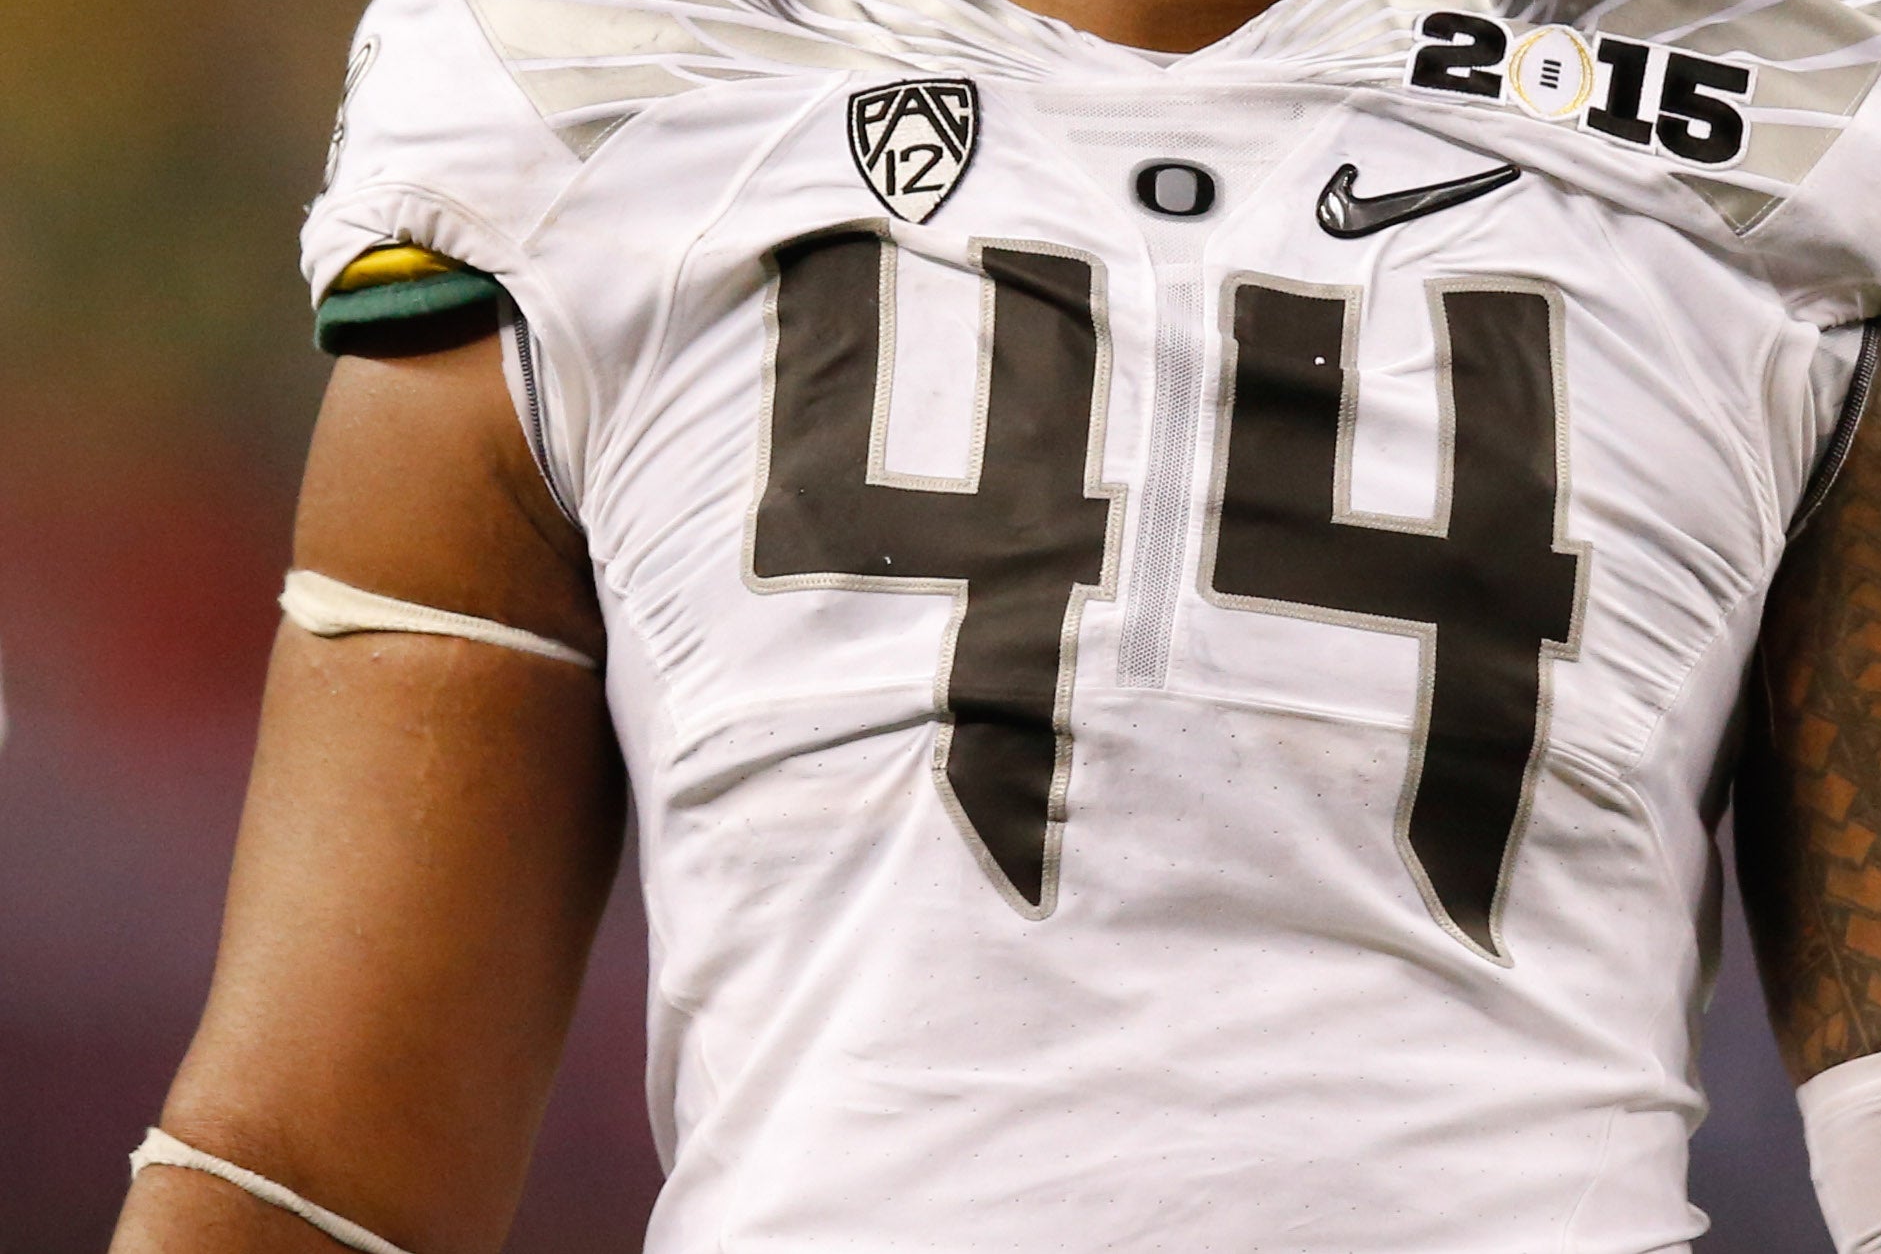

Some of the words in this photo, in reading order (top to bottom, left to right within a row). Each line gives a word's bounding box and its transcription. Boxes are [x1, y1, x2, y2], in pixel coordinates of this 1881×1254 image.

[855, 86, 970, 172] PAC
[885, 143, 945, 196] 12
[741, 218, 1593, 969] 44
